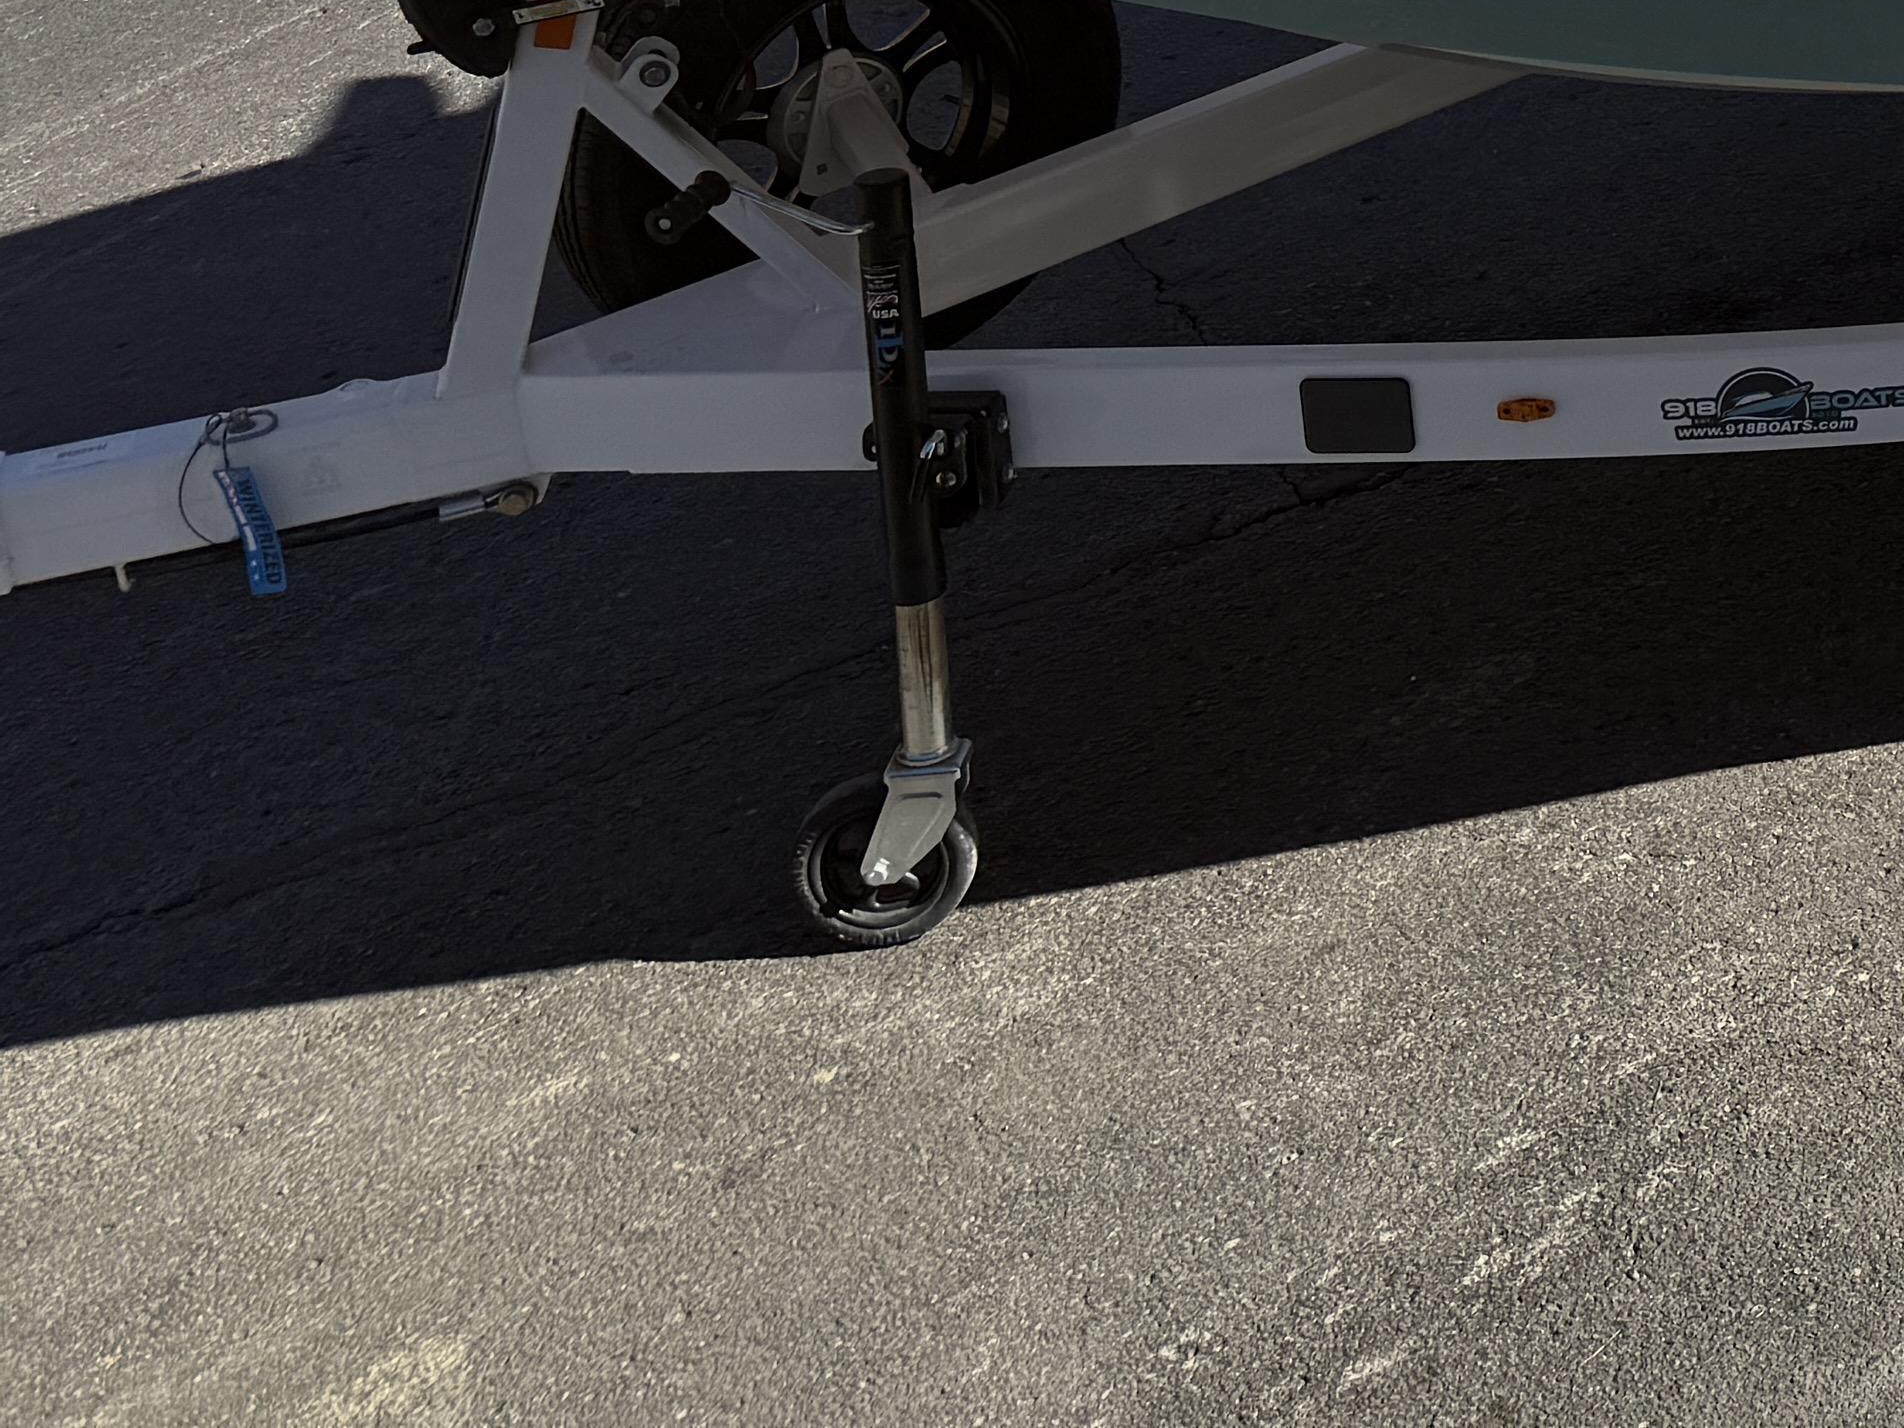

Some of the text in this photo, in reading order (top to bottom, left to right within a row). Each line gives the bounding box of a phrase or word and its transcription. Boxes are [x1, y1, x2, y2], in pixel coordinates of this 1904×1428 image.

[872, 308, 900, 319] USA
[1663, 400, 1717, 418] 918
[1677, 418, 1855, 439] www.918BOATS.com
[238, 479, 283, 584] WINTERIZED
